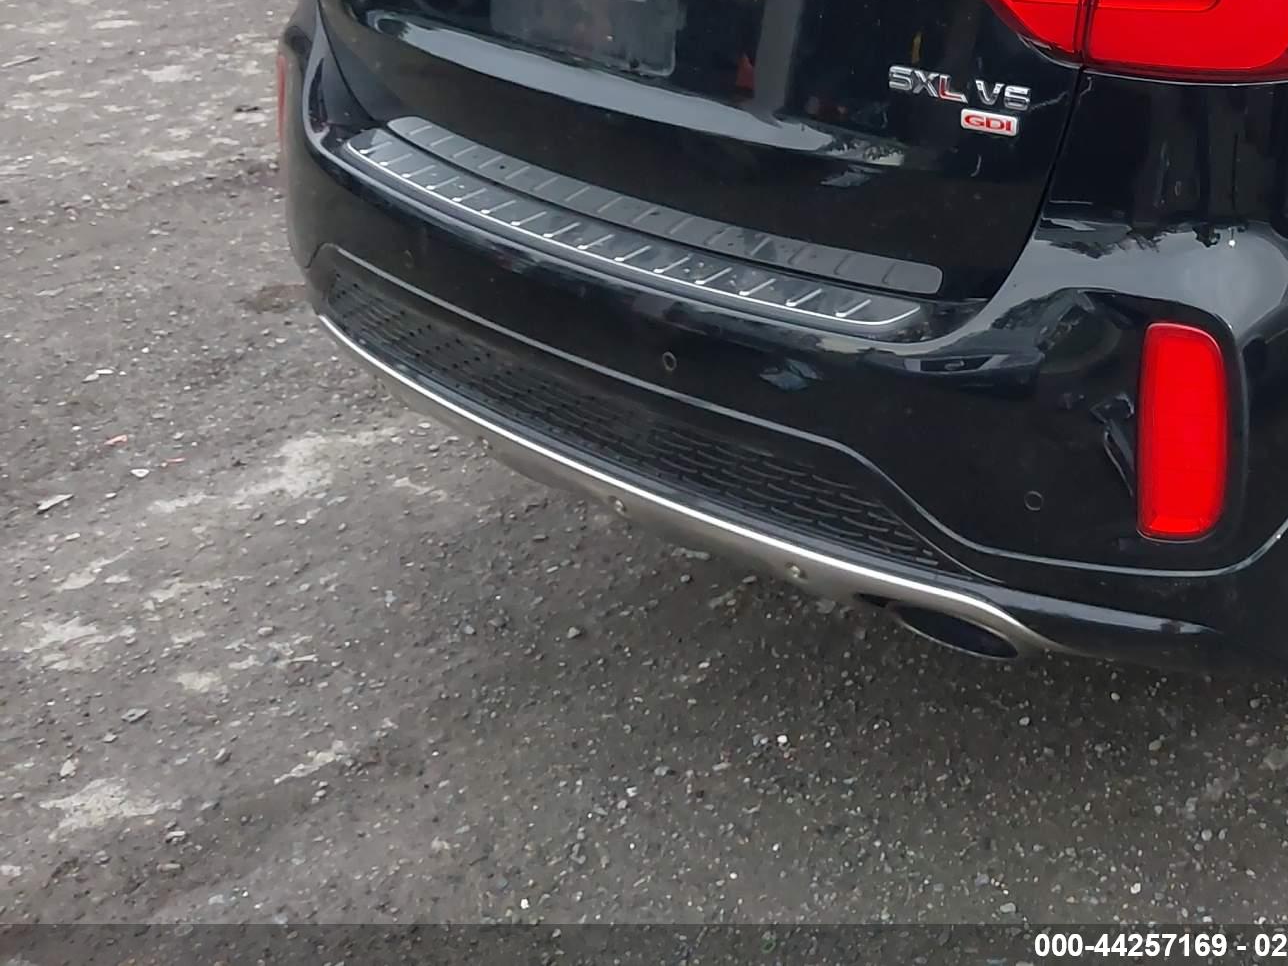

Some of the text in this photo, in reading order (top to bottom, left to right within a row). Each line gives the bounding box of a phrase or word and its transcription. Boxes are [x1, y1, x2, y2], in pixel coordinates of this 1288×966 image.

[888, 65, 1031, 112] SXL V6
[964, 114, 1012, 133] GDI
